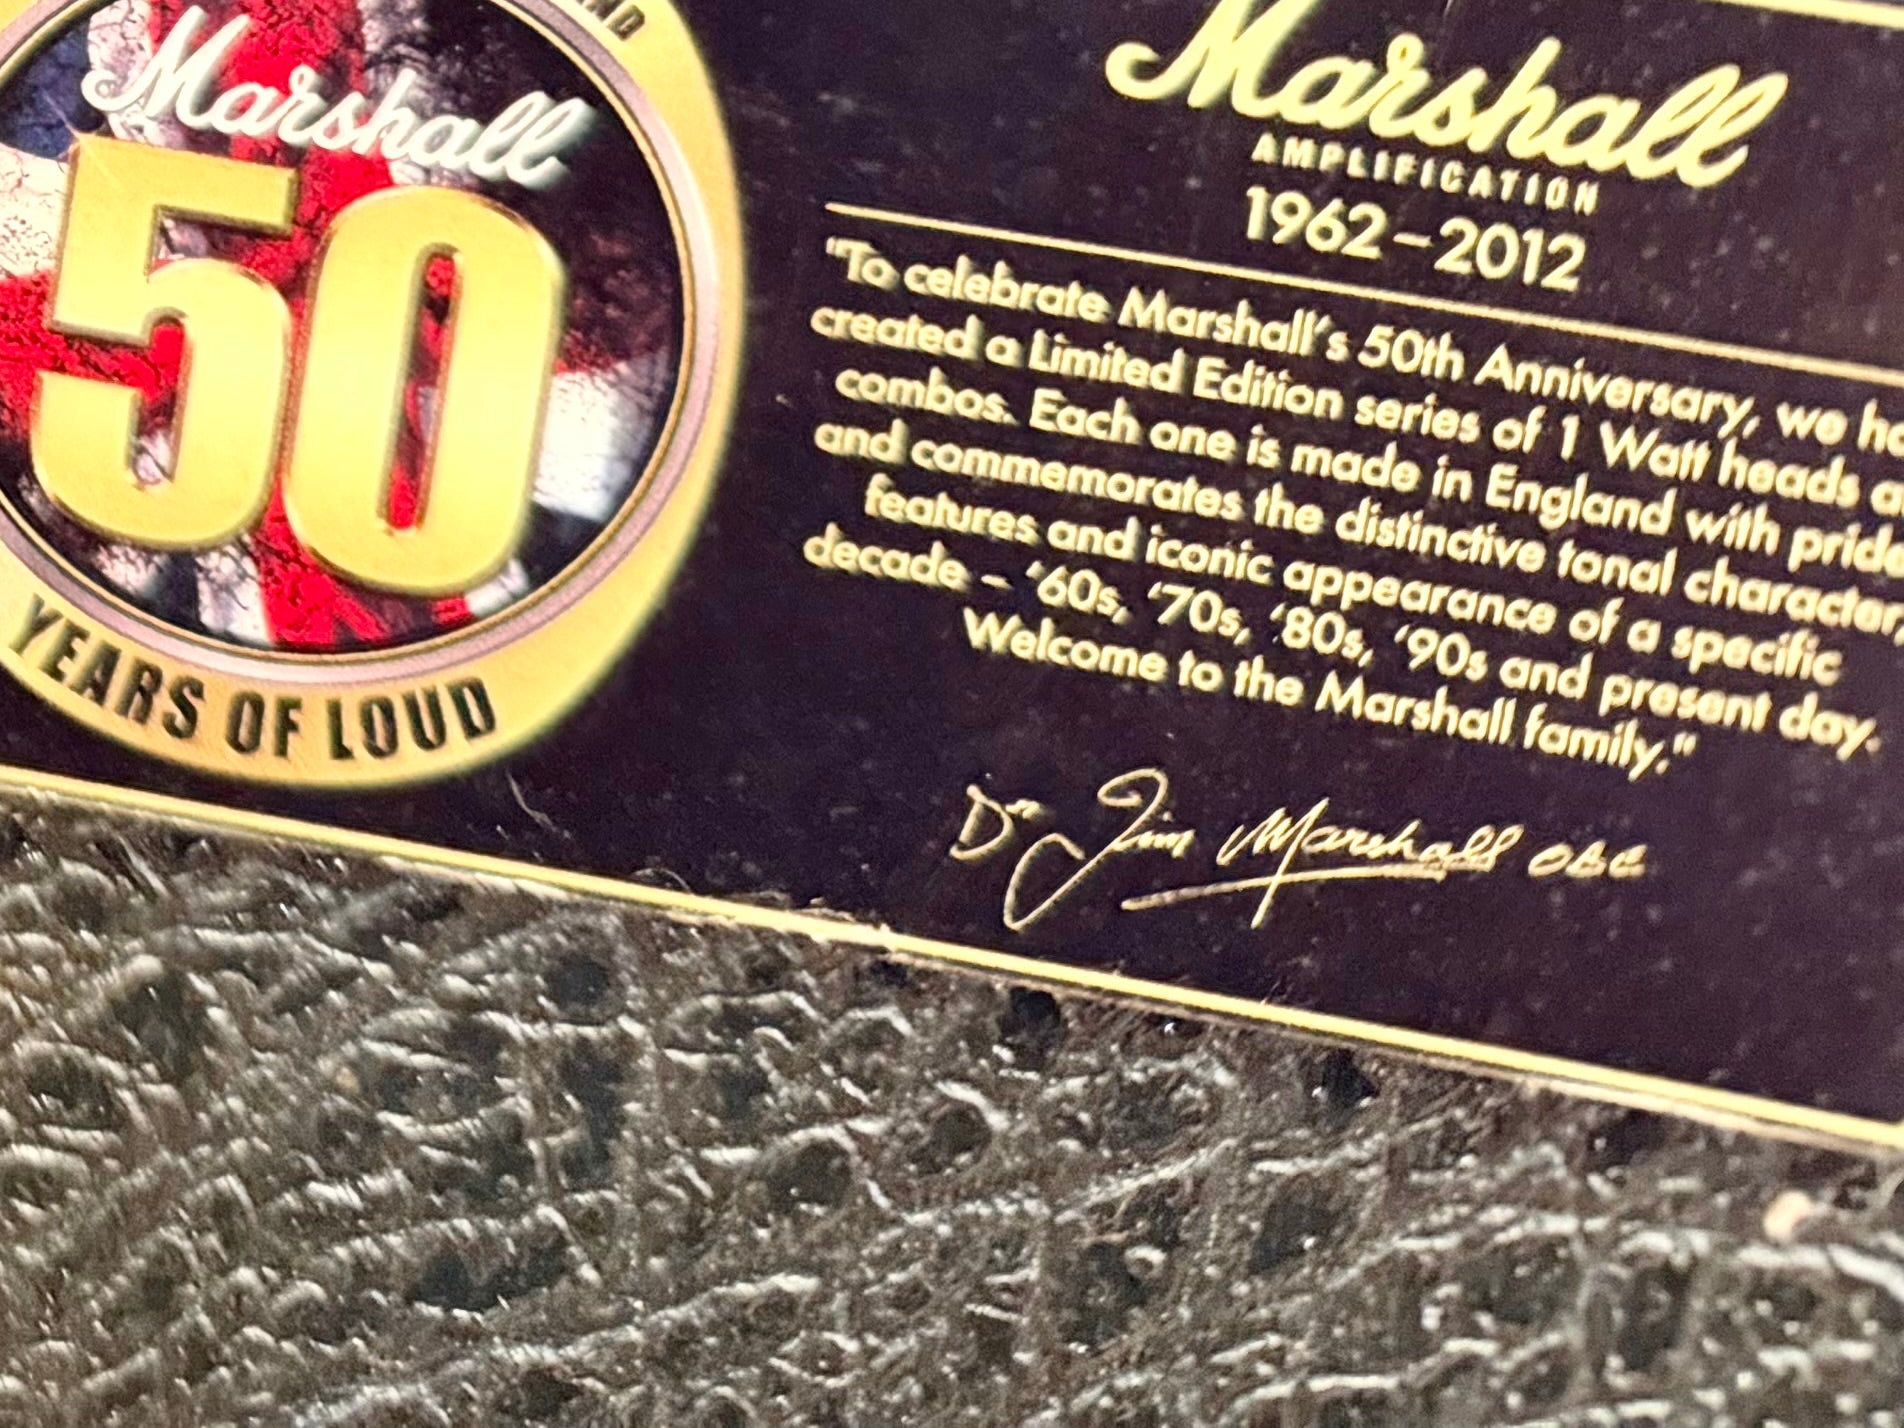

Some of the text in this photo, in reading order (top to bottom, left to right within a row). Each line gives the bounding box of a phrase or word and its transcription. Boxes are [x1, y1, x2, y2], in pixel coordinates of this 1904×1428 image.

[82, 4, 592, 187] Marshall
[1251, 133, 1601, 217] AMPLIFICATION
[28, 130, 568, 599] 50
[810, 304, 982, 362] created
[985, 334, 1021, 367] a
[1029, 328, 1187, 396] Limited
[1193, 355, 1344, 421] Edition
[1355, 392, 1481, 444] series
[1493, 405, 1547, 454] of
[1560, 414, 1582, 461] 1
[1599, 420, 1714, 482] Watt
[1717, 437, 1860, 509] heads
[904, 253, 1110, 324] celebrate
[1357, 324, 1465, 382] 50th
[1473, 343, 1760, 439] Anniversary,
[1776, 401, 1849, 445] we
[813, 418, 907, 465] and
[911, 439, 1245, 521] commemorates
[1253, 482, 1325, 536] the
[1335, 496, 1546, 574] distinctive
[1557, 538, 1678, 597] tonal
[835, 364, 1019, 426] combos.
[1030, 387, 1142, 445] Each
[1150, 425, 1237, 464] one
[1246, 423, 1281, 469] is
[1290, 442, 1422, 493] made
[1432, 454, 1473, 502] in
[1486, 461, 1679, 536] England
[1685, 502, 1780, 558] with
[803, 522, 971, 592] decade
[1499, 652, 1593, 701] and
[1598, 672, 1773, 732] present
[1779, 691, 1882, 761] day.
[864, 473, 1844, 687] features and iconic appearance of a specific
[963, 607, 1168, 684] Welcome
[1179, 650, 1223, 692] to
[1234, 654, 1305, 707] the
[1314, 671, 1516, 744] Marshall
[8, 593, 497, 760] YEARS OF LOUD
